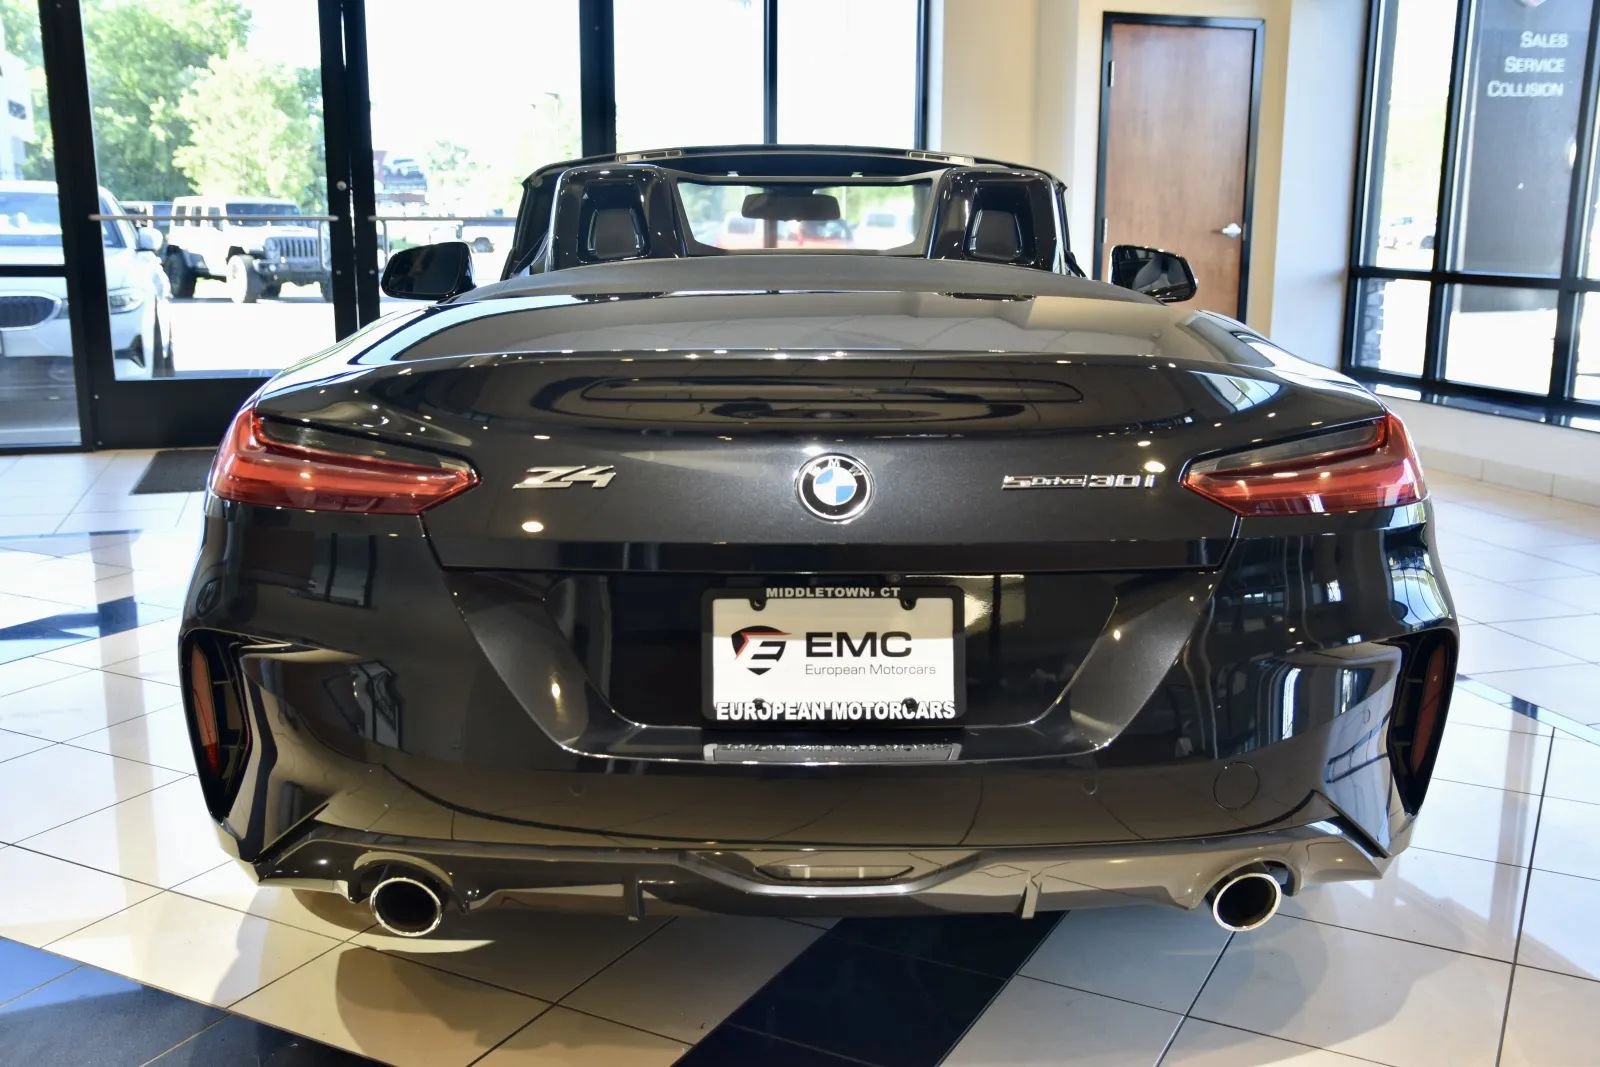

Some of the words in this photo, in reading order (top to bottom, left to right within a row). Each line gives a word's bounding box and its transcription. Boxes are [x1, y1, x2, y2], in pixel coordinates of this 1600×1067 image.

[1521, 32, 1567, 48] SALES
[1505, 56, 1565, 73] SERVICE
[512, 465, 616, 488] Z4
[766, 587, 875, 598] MIDDLETOWN,
[880, 587, 901, 597] CT
[805, 631, 912, 658] EMC
[805, 664, 865, 677] European
[870, 664, 936, 675] Motorcars
[716, 701, 828, 720] EUROPEAN
[832, 701, 955, 719] MOTORCARS
